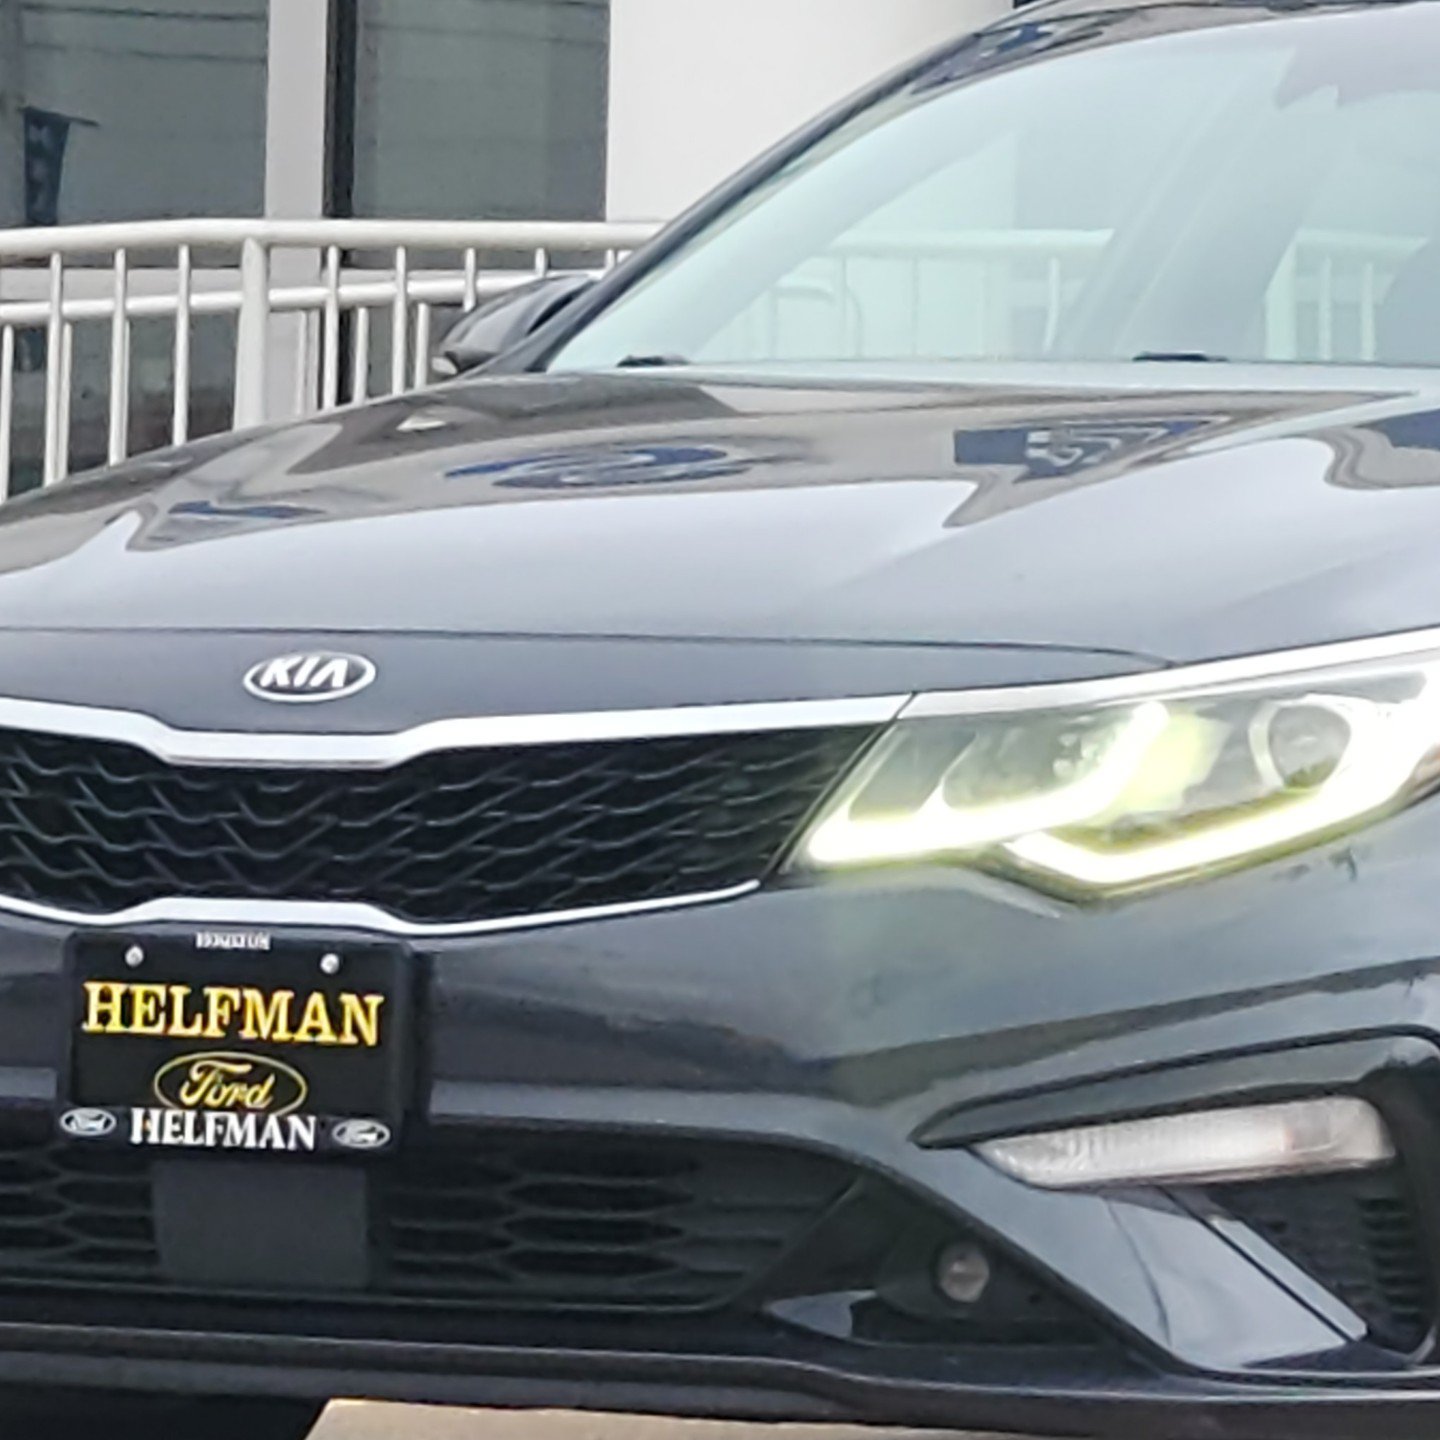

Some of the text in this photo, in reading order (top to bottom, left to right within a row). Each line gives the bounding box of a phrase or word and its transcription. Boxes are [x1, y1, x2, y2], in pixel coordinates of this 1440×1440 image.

[260, 656, 349, 688] KIA
[81, 980, 385, 1047] HELFMAN
[178, 1059, 276, 1110] Ford
[129, 1107, 317, 1151] HELFMAN
